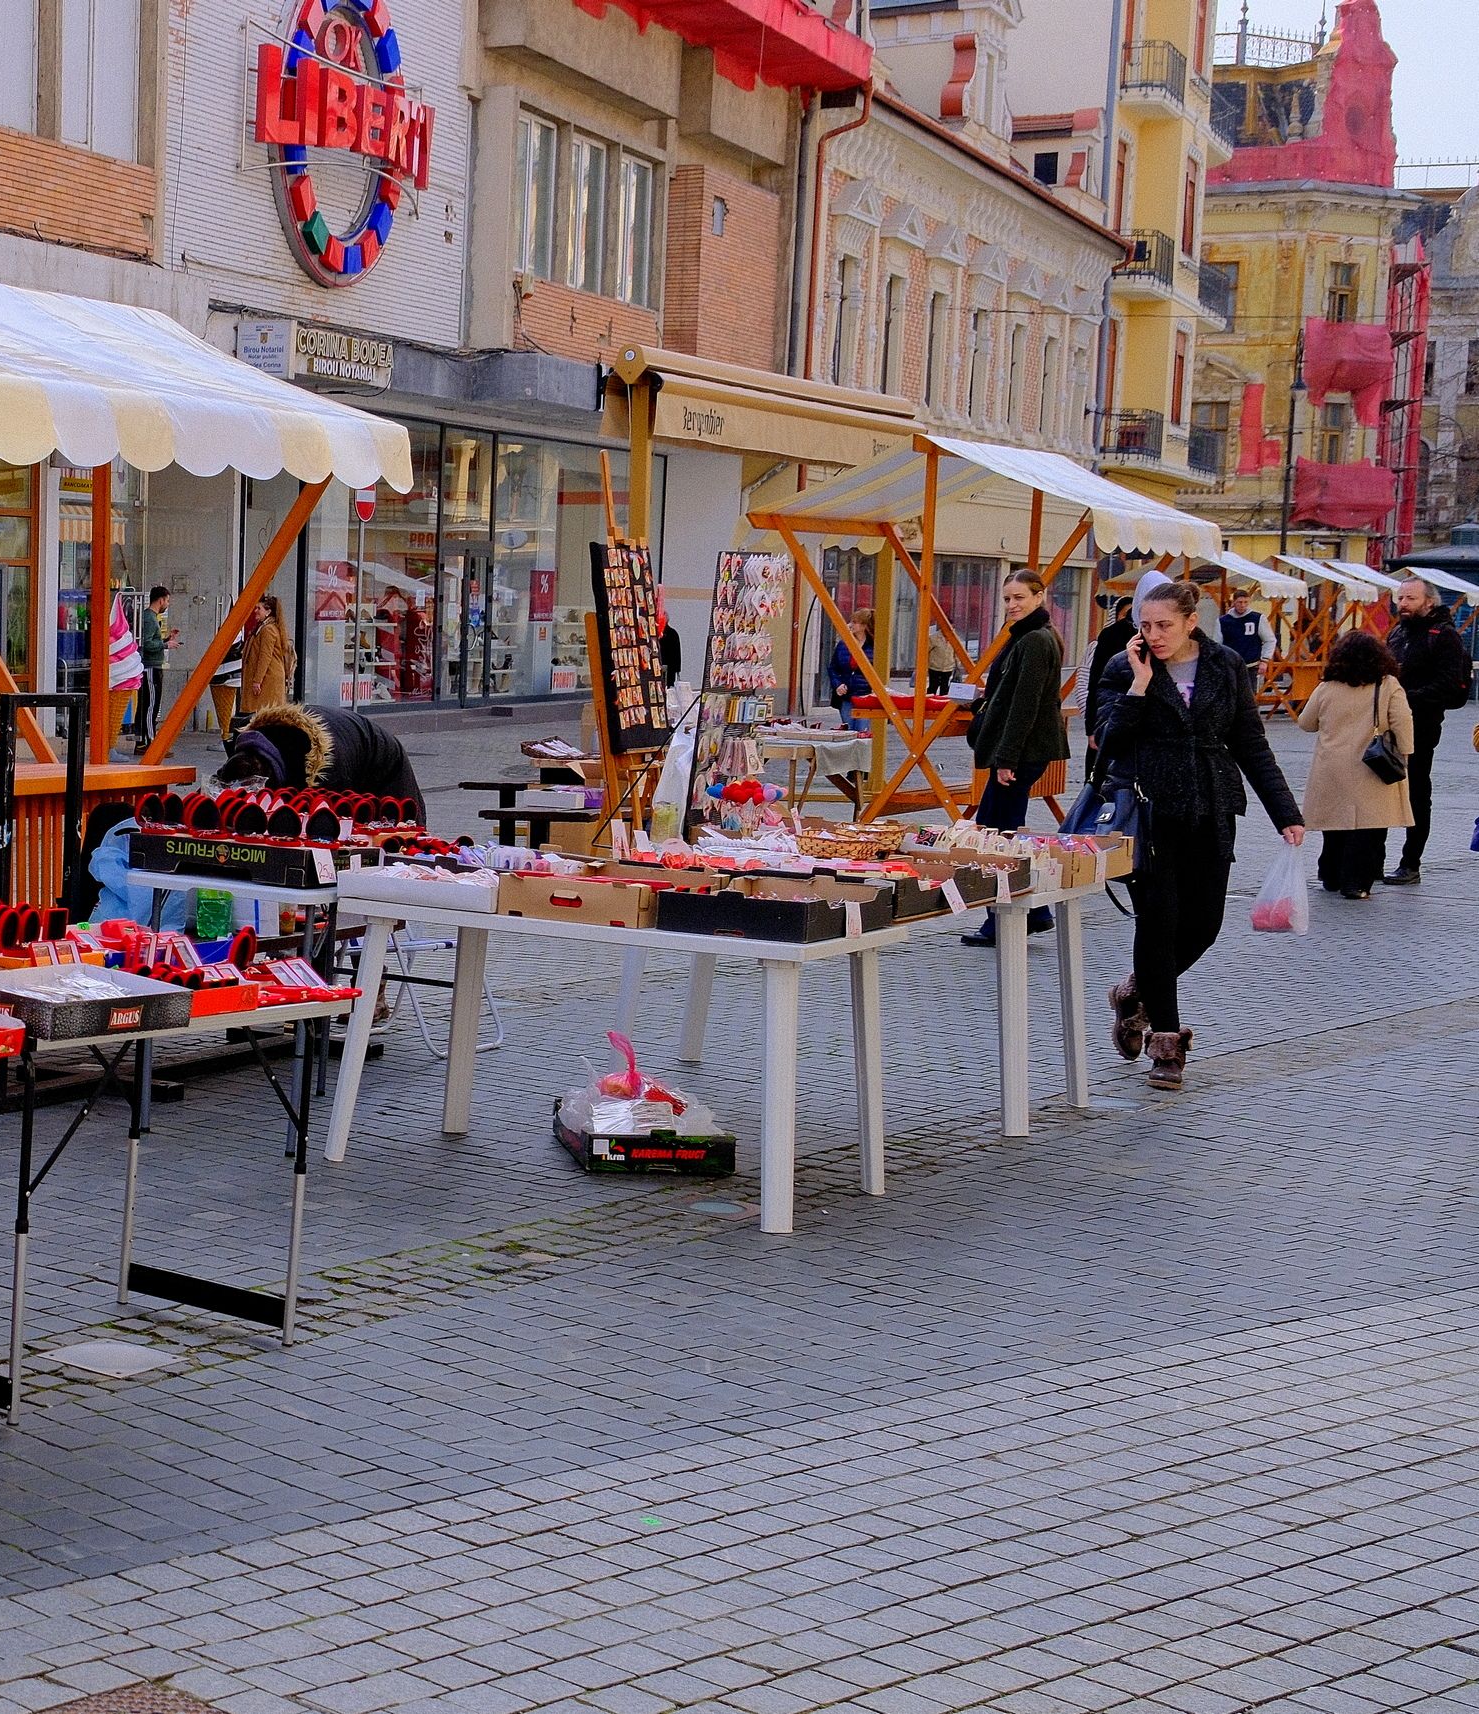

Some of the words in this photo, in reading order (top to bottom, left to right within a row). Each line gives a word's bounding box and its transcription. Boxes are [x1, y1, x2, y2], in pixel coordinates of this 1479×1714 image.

[296, 327, 350, 361] CORINA
[350, 336, 395, 369] BODEA
[312, 357, 340, 377] BIROU
[339, 362, 378, 383] NOTARIAL
[1244, 622, 1256, 636] D
[110, 1010, 140, 1026] ARGUS
[630, 1148, 673, 1160] KAREMA
